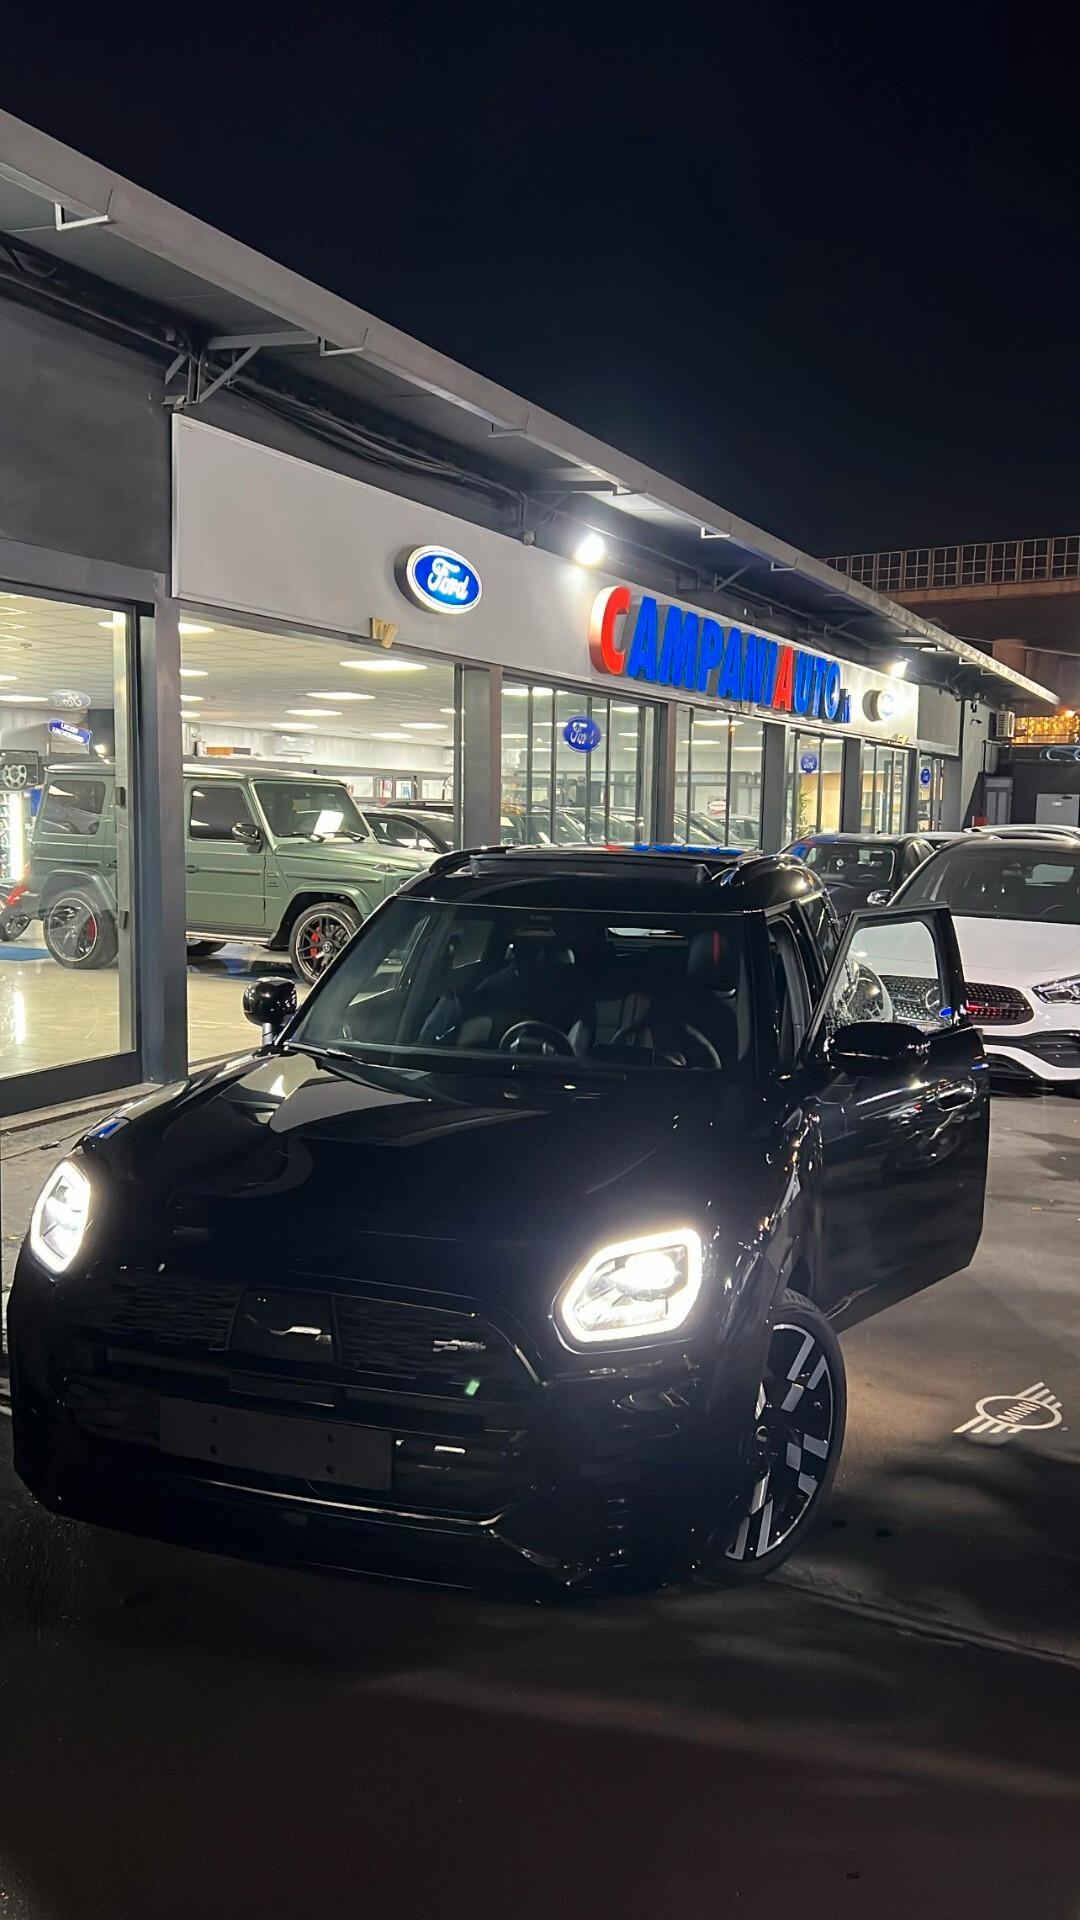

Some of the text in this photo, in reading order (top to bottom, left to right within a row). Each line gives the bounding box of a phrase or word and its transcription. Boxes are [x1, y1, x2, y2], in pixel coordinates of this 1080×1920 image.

[427, 557, 470, 600] Ford
[590, 585, 841, 720] CAMPANIAUTO
[995, 1400, 1041, 1423] MINI
